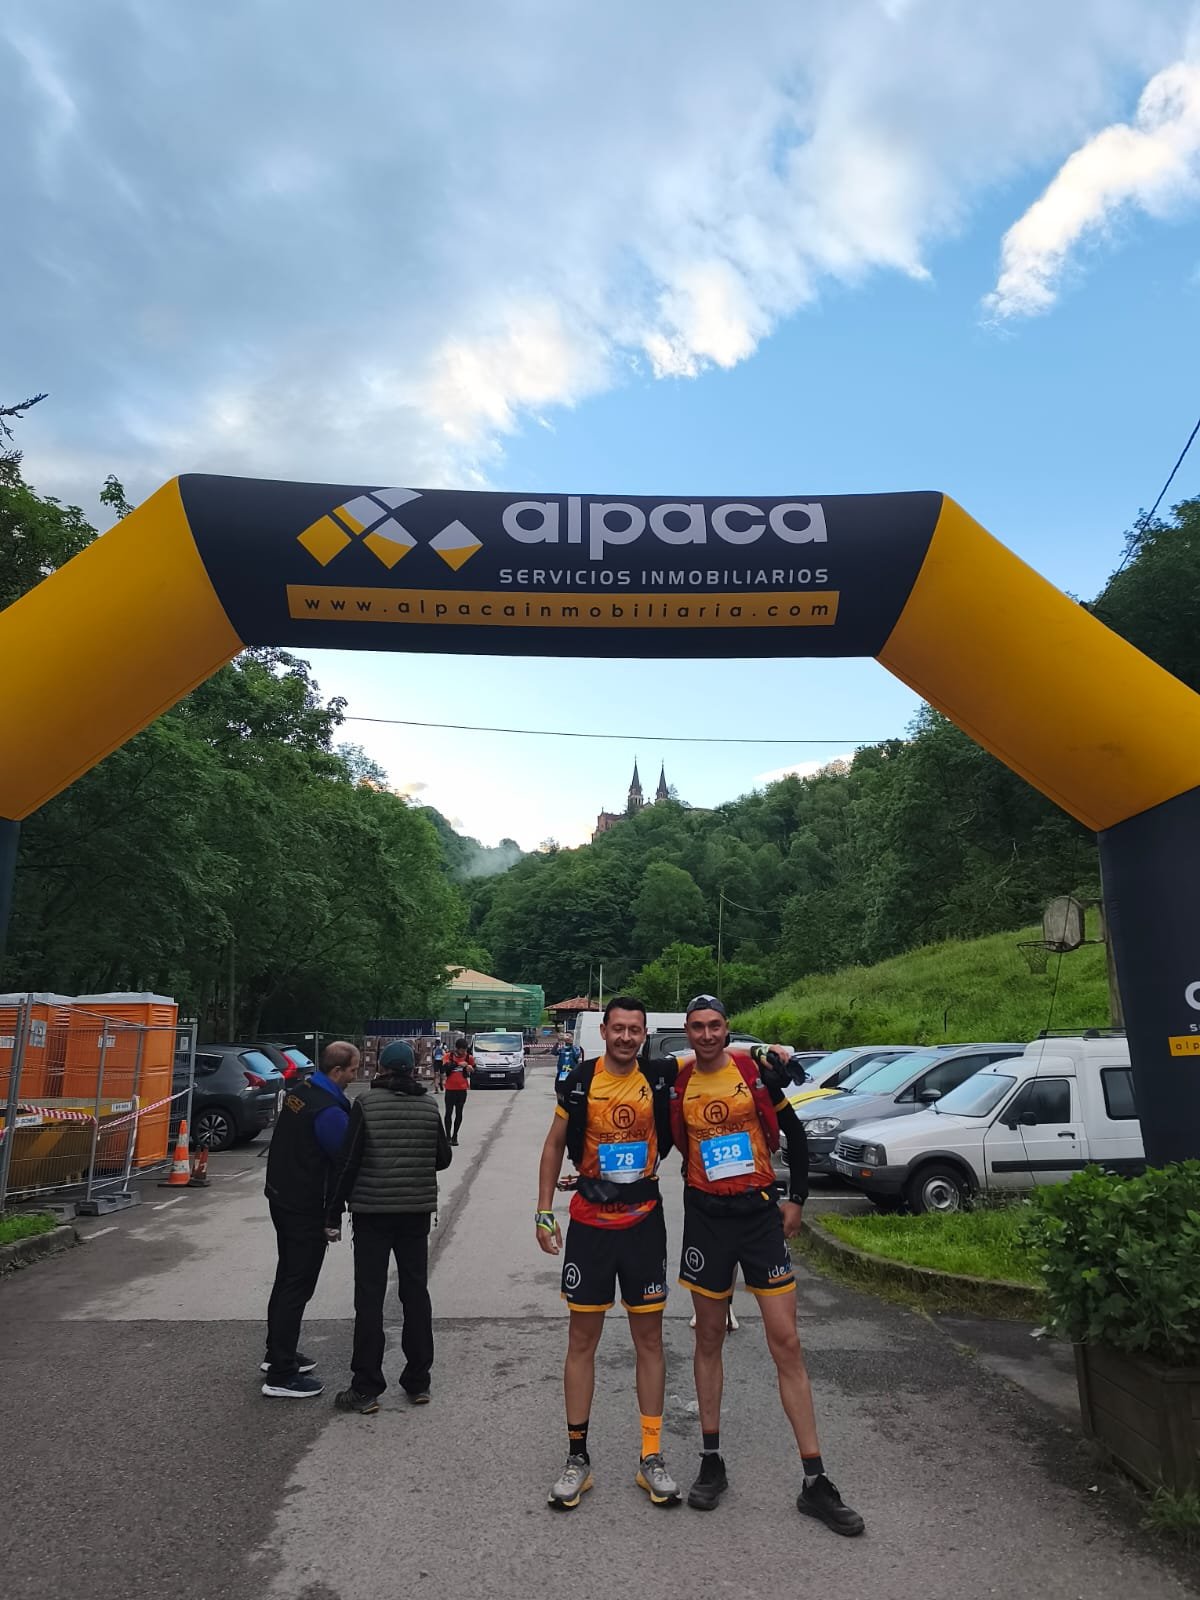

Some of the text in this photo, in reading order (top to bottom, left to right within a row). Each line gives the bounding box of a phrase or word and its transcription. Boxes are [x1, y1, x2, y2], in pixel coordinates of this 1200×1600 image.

[502, 496, 828, 560] alpaca
[499, 568, 829, 585] SERVICIOS INMOBILIARIOS
[304, 598, 829, 618] www.alpacainmobiliaria.com
[615, 1152, 635, 1167] 78
[712, 1143, 742, 1162] 328
